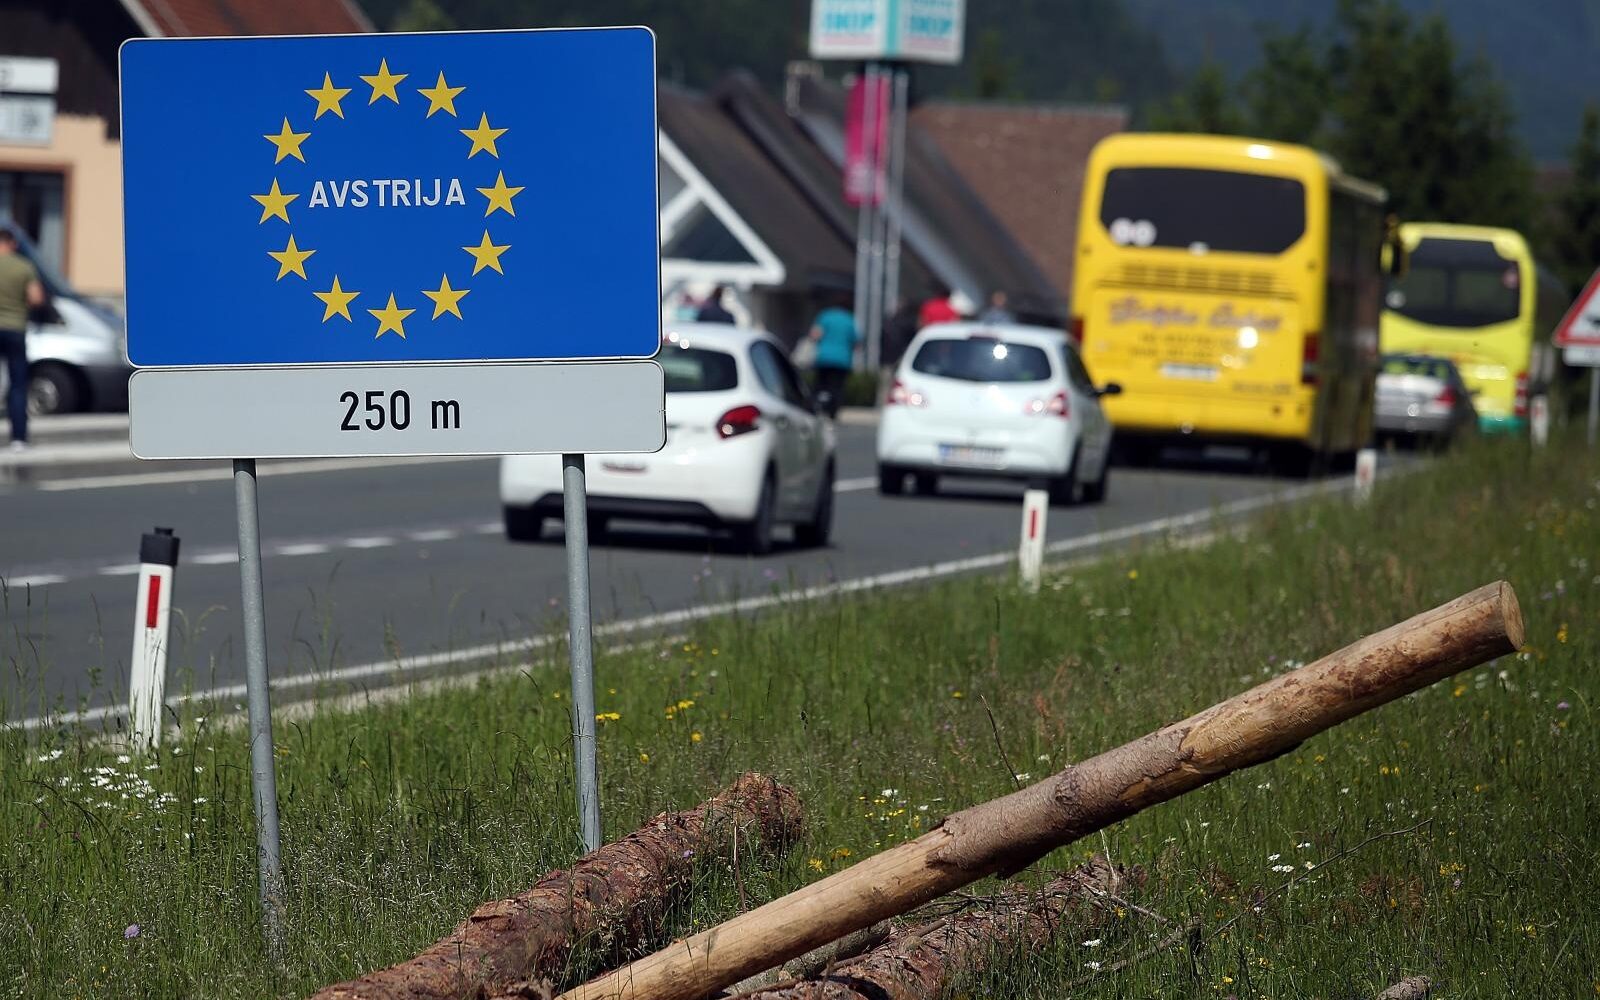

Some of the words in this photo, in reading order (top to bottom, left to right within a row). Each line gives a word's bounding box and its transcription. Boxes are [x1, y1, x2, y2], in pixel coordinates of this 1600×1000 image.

[308, 178, 466, 208] AVSTRIJA
[339, 390, 411, 431] 250
[431, 399, 461, 430] m
